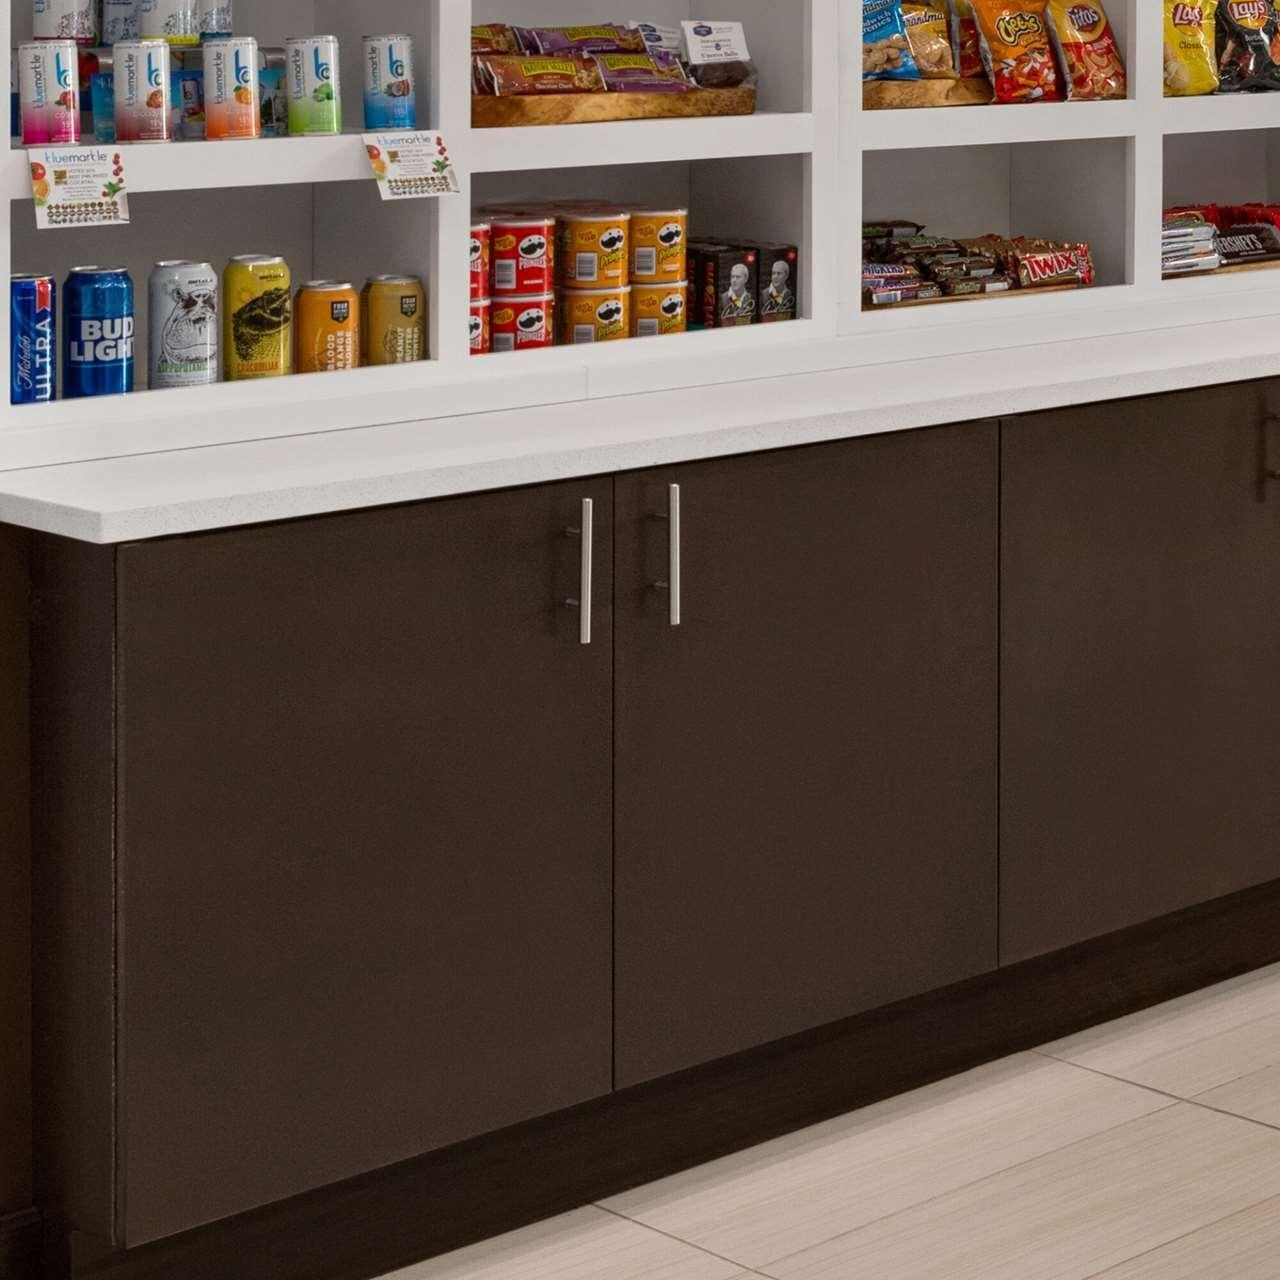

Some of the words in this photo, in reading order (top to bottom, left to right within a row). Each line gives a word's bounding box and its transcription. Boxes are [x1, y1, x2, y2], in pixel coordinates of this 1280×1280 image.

[997, 14, 1040, 44] Cheetos
[81, 316, 134, 341] BUD
[35, 315, 51, 402] ULTRA
